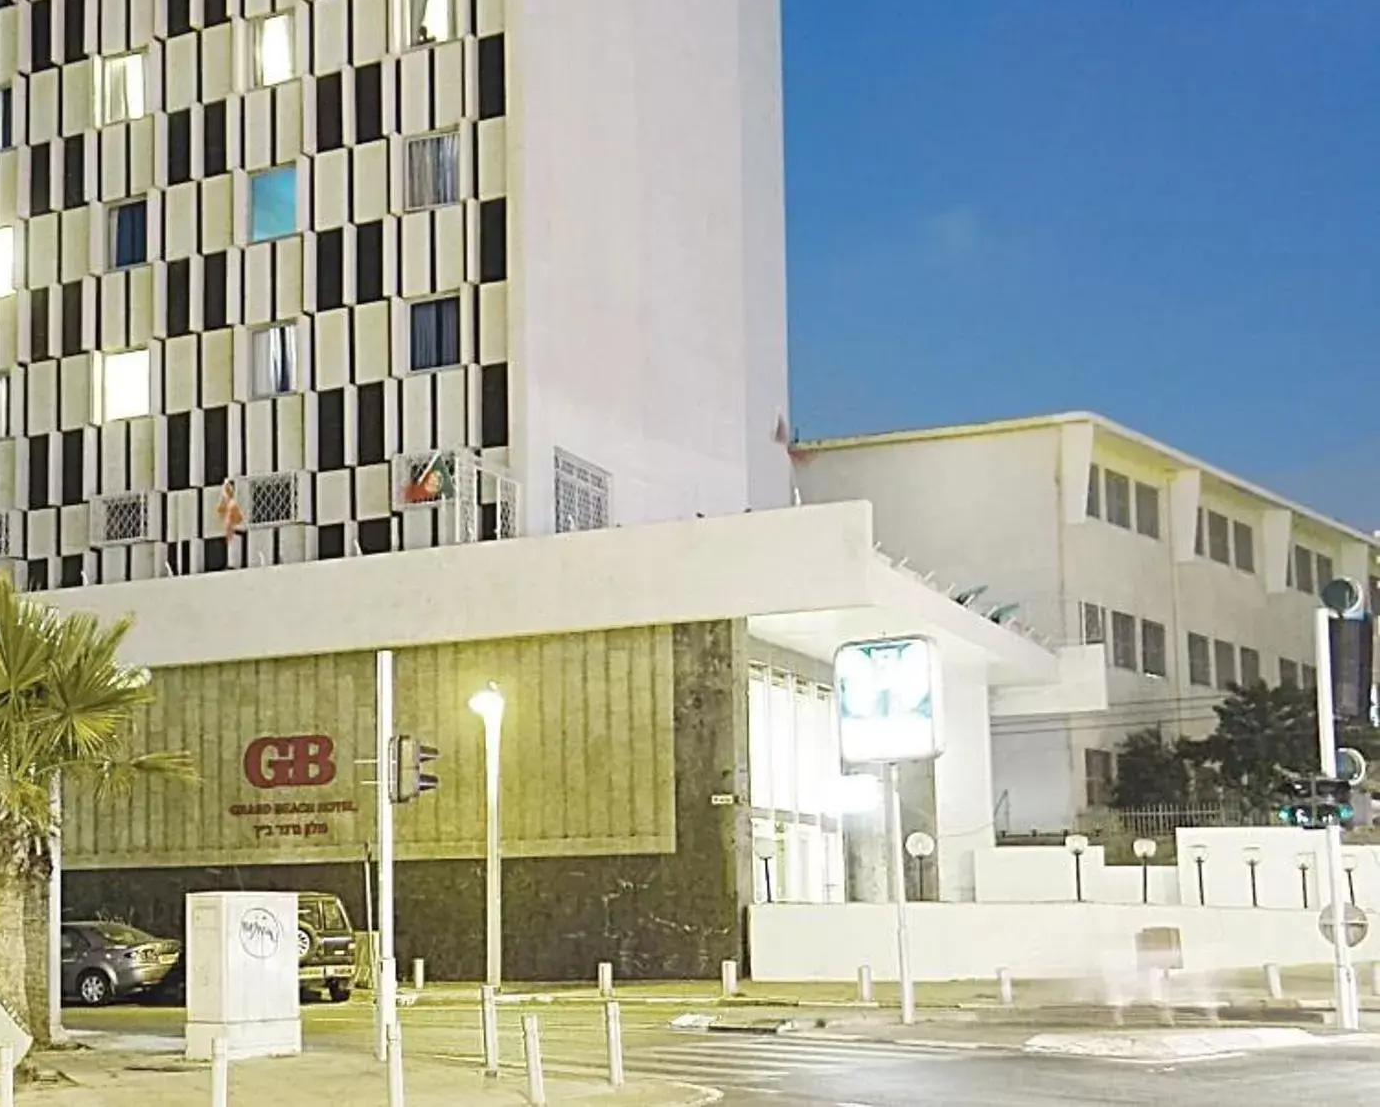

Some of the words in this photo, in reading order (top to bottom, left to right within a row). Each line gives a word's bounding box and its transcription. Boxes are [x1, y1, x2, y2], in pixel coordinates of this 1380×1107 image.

[244, 735, 336, 788] GB
[274, 802, 315, 814] BEACH
[317, 800, 359, 812] HOTEL
